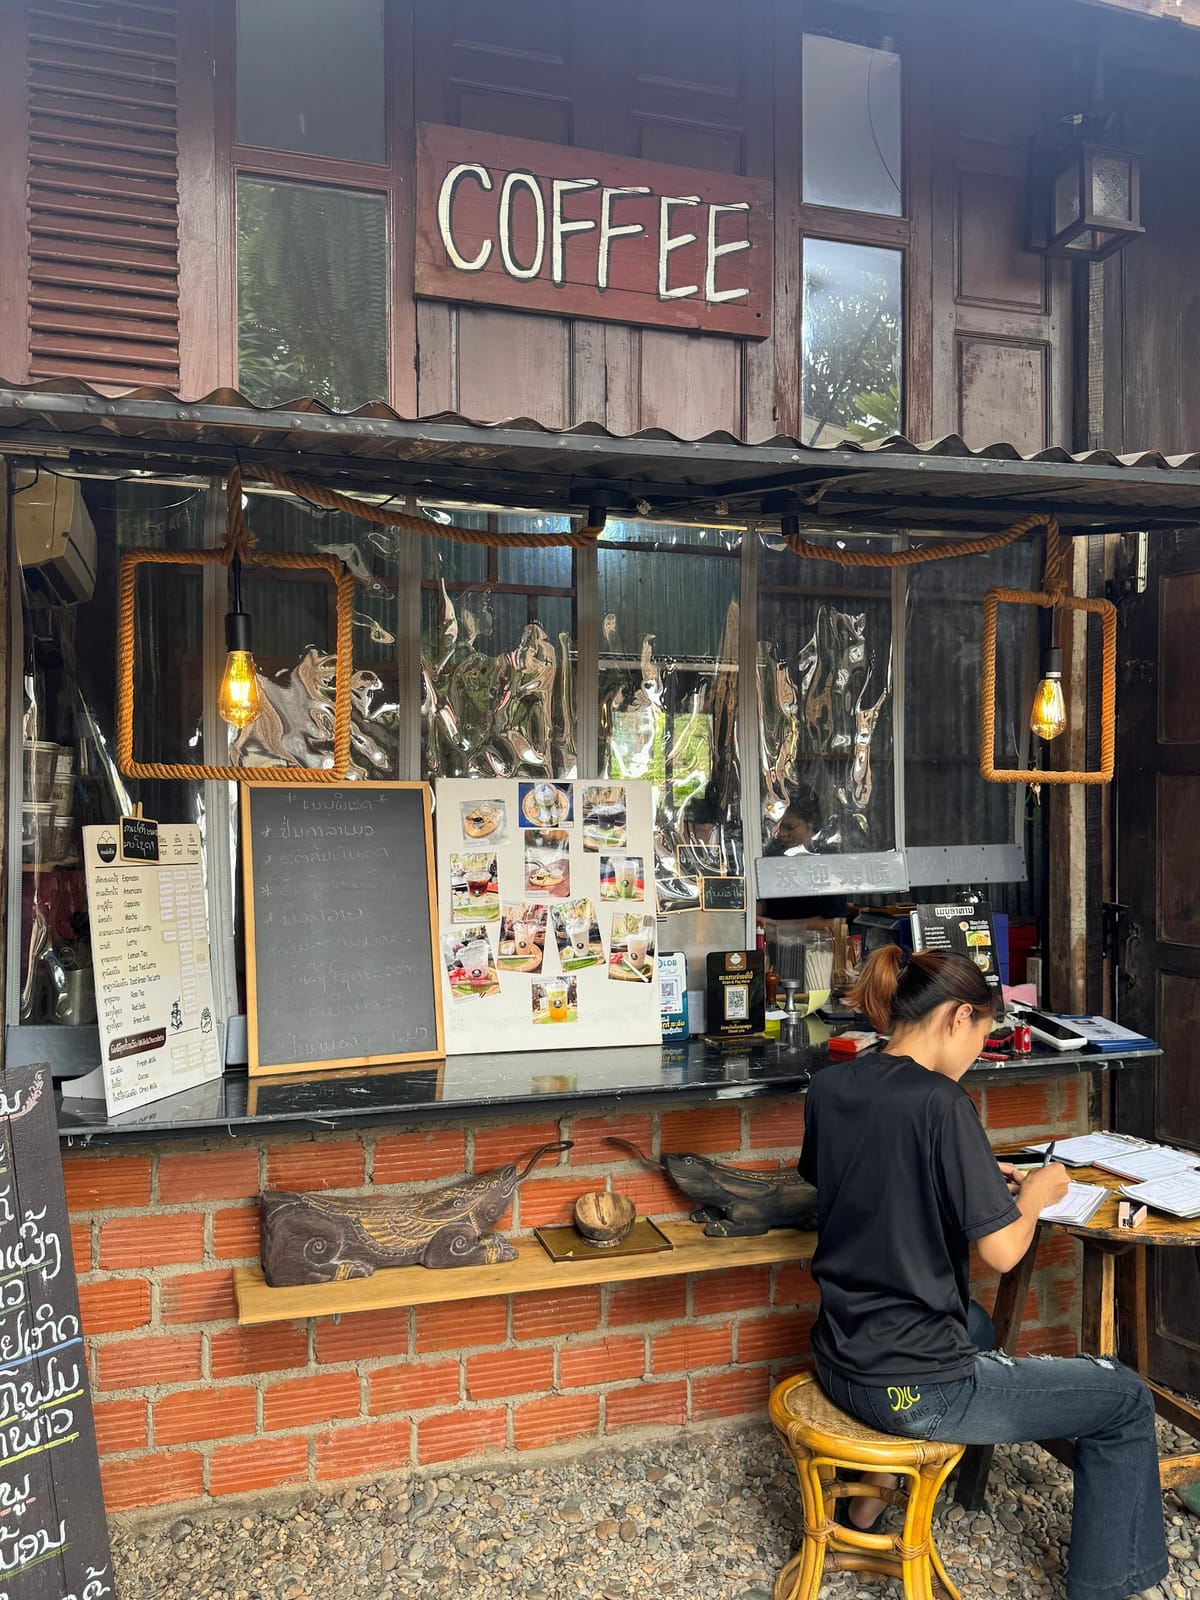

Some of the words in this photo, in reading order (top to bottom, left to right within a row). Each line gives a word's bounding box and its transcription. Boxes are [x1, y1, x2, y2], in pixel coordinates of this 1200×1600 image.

[437, 163, 750, 302] COFFEE
[775, 863, 891, 889] 欢迎光临
